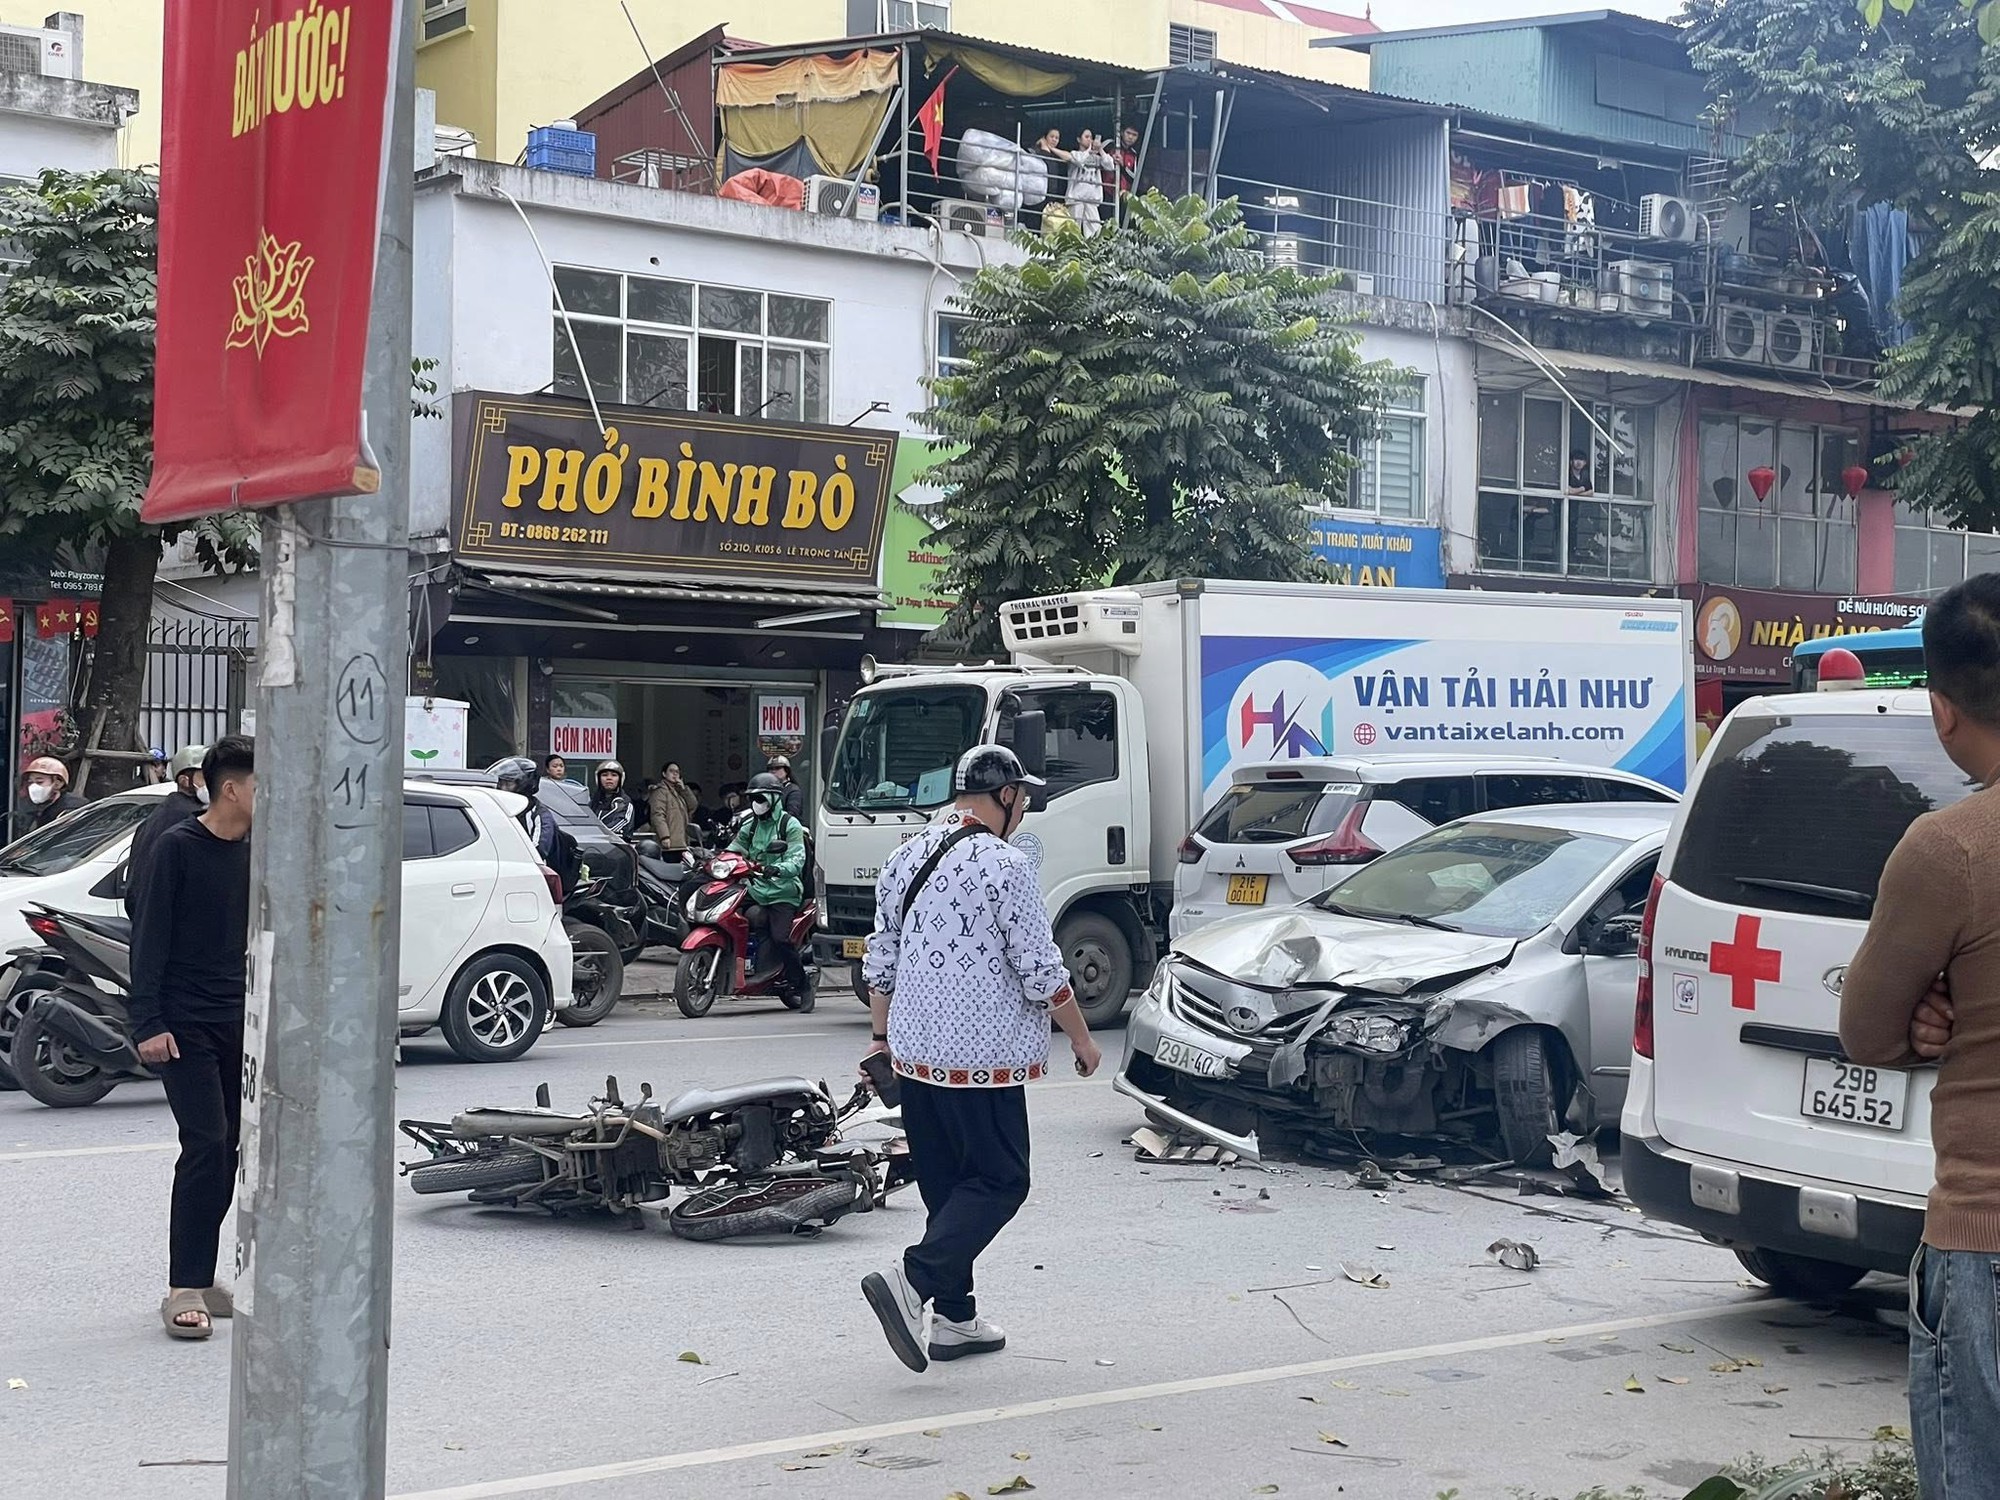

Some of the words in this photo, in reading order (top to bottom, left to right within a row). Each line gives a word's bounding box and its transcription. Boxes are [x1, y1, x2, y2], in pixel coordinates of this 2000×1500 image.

[232, 8, 264, 138] ĐẤT
[501, 426, 630, 514] PHỞ
[631, 442, 776, 526] BÌNH
[781, 454, 855, 531] BÒ
[526, 524, 560, 540] 0868
[561, 527, 588, 542] 262
[589, 529, 609, 544] 111
[1326, 532, 1358, 549] TRANG
[1361, 530, 1384, 550] XUẤT
[1387, 533, 1412, 553] KHẨU
[719, 538, 733, 552] SỐ
[776, 547, 782, 555] 6
[799, 548, 830, 560] TRỌNG
[1359, 565, 1395, 587] AN
[1010, 601, 1041, 610] THERMAL
[1855, 598, 1872, 614] NÚI
[1873, 601, 1908, 617] HƯƠNG
[1751, 615, 1806, 647] NHÀ
[1353, 669, 1429, 713] VẬN
[1441, 667, 1497, 708] TẢI
[1510, 668, 1568, 708] HẢI
[1580, 677, 1653, 709] NHƯ
[762, 700, 783, 731] PHỞ
[786, 702, 800, 731] BÒ
[554, 723, 579, 753] CƠM
[583, 727, 612, 754] RANG
[1384, 722, 1624, 741] vantaixelanh.com
[1239, 876, 1257, 888] 21E
[1231, 889, 1259, 902] 001.11
[1665, 946, 1709, 963] HYUNDAI
[1833, 1064, 1878, 1094] 29B
[1813, 1090, 1893, 1126] 645.52
